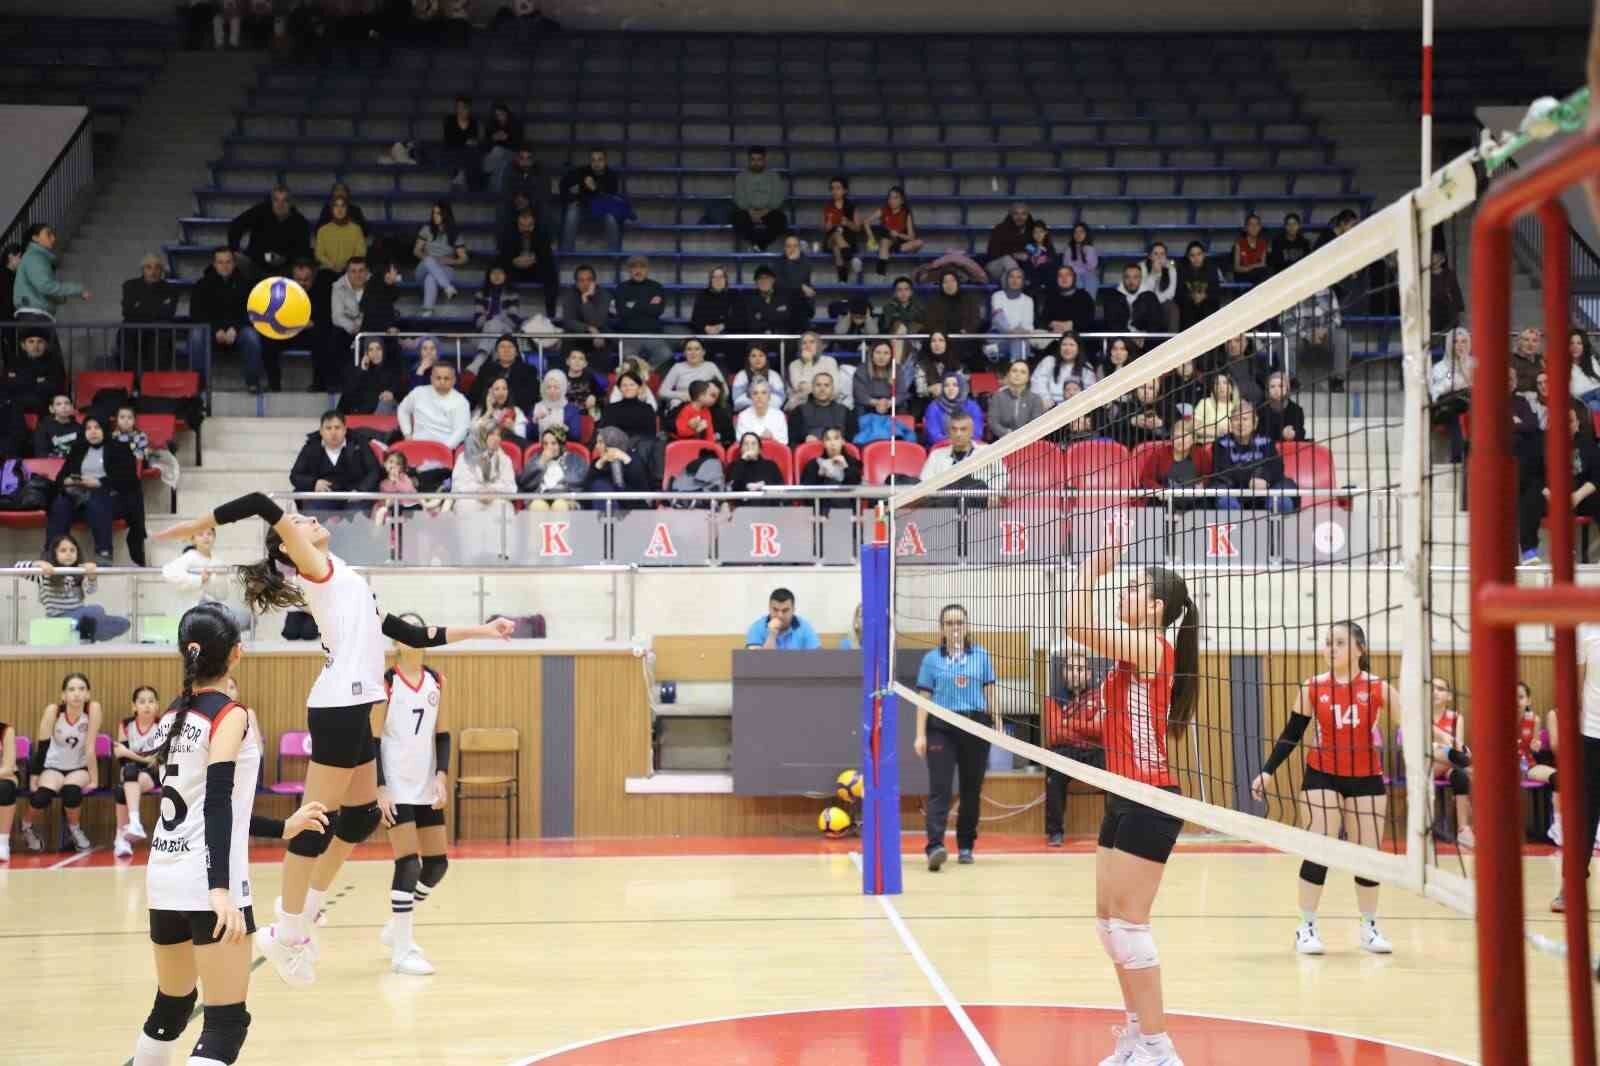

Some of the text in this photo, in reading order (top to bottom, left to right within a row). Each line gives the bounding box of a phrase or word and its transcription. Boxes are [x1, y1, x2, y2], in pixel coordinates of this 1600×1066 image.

[540, 521, 572, 556] K
[645, 522, 676, 557] A
[750, 522, 781, 557] R
[896, 522, 927, 556] A
[1000, 521, 1029, 556] B
[1206, 522, 1238, 557] K
[412, 708, 425, 735] 7
[1329, 704, 1360, 729] 14
